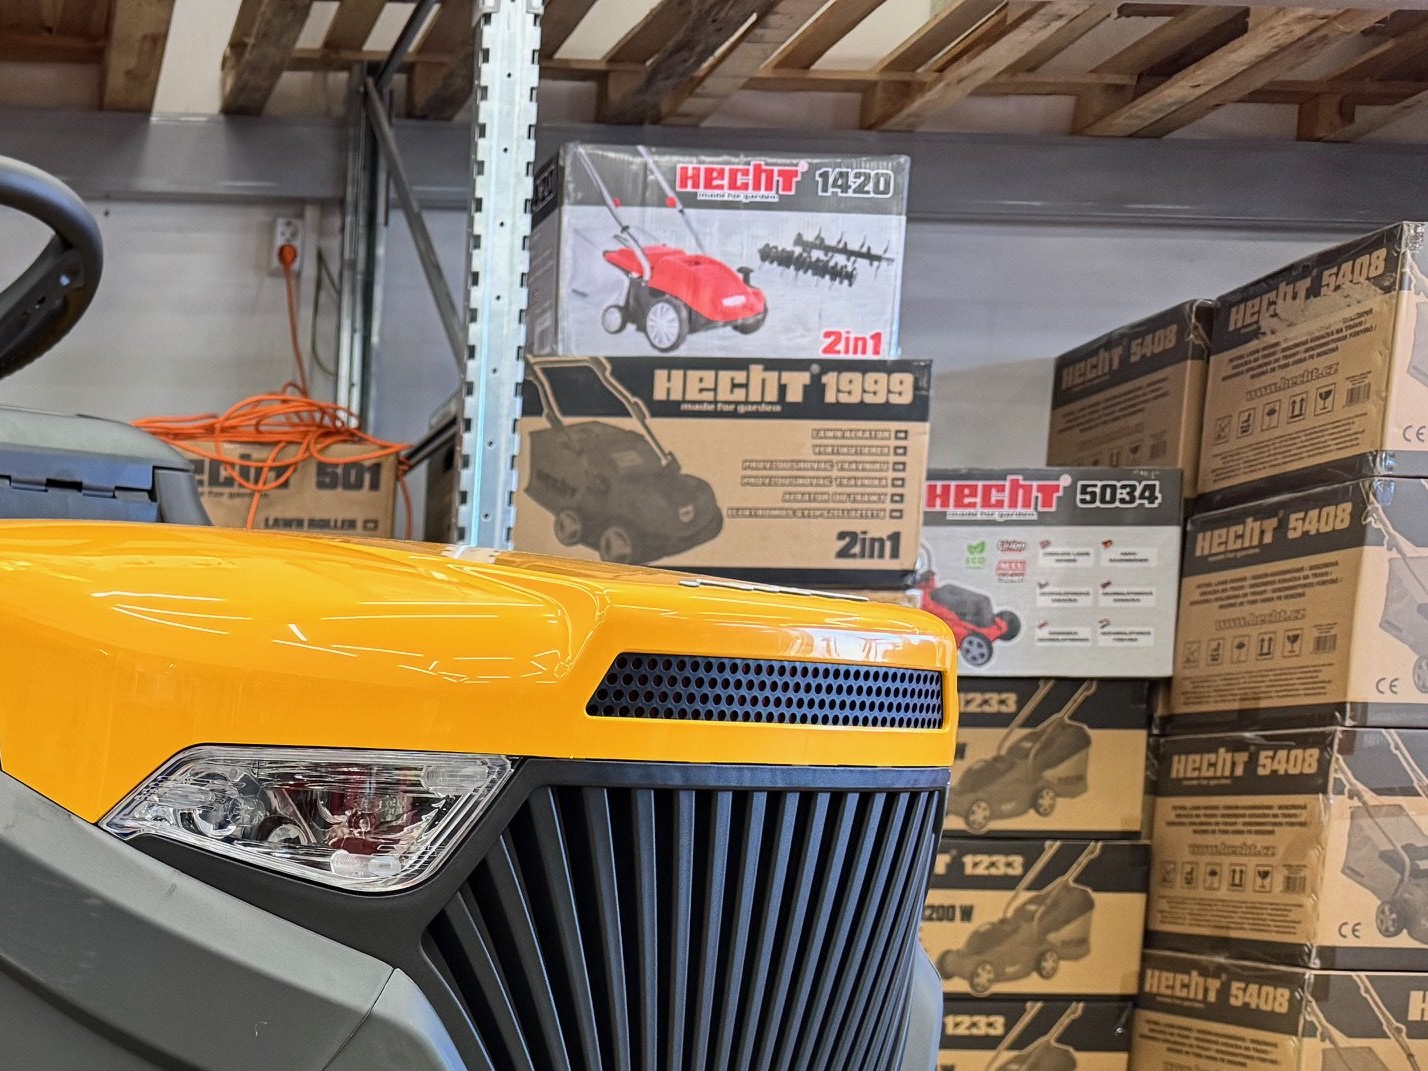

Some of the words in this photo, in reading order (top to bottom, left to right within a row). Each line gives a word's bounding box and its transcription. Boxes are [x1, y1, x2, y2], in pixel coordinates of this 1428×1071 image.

[818, 168, 893, 197] 1420
[1321, 248, 1388, 296] 5408
[821, 331, 882, 356] 2in1
[1130, 324, 1178, 362] 5408
[821, 371, 914, 405] 1999
[1246, 362, 1339, 399] www.hecht.cz
[681, 403, 713, 411] made
[717, 403, 735, 411] for
[737, 404, 782, 414] garden
[316, 461, 381, 491] 501
[1078, 482, 1159, 506] 5034
[265, 517, 304, 529] LAWN
[307, 518, 356, 531] ROLLER
[1287, 502, 1353, 540] 5408
[835, 530, 901, 560] 2in1
[959, 692, 1018, 714] 1233
[1256, 748, 1320, 776] 5408
[962, 854, 1023, 876] 1233
[959, 905, 974, 921] W
[1229, 981, 1290, 1014] 5408
[945, 1015, 1006, 1036] 1233
